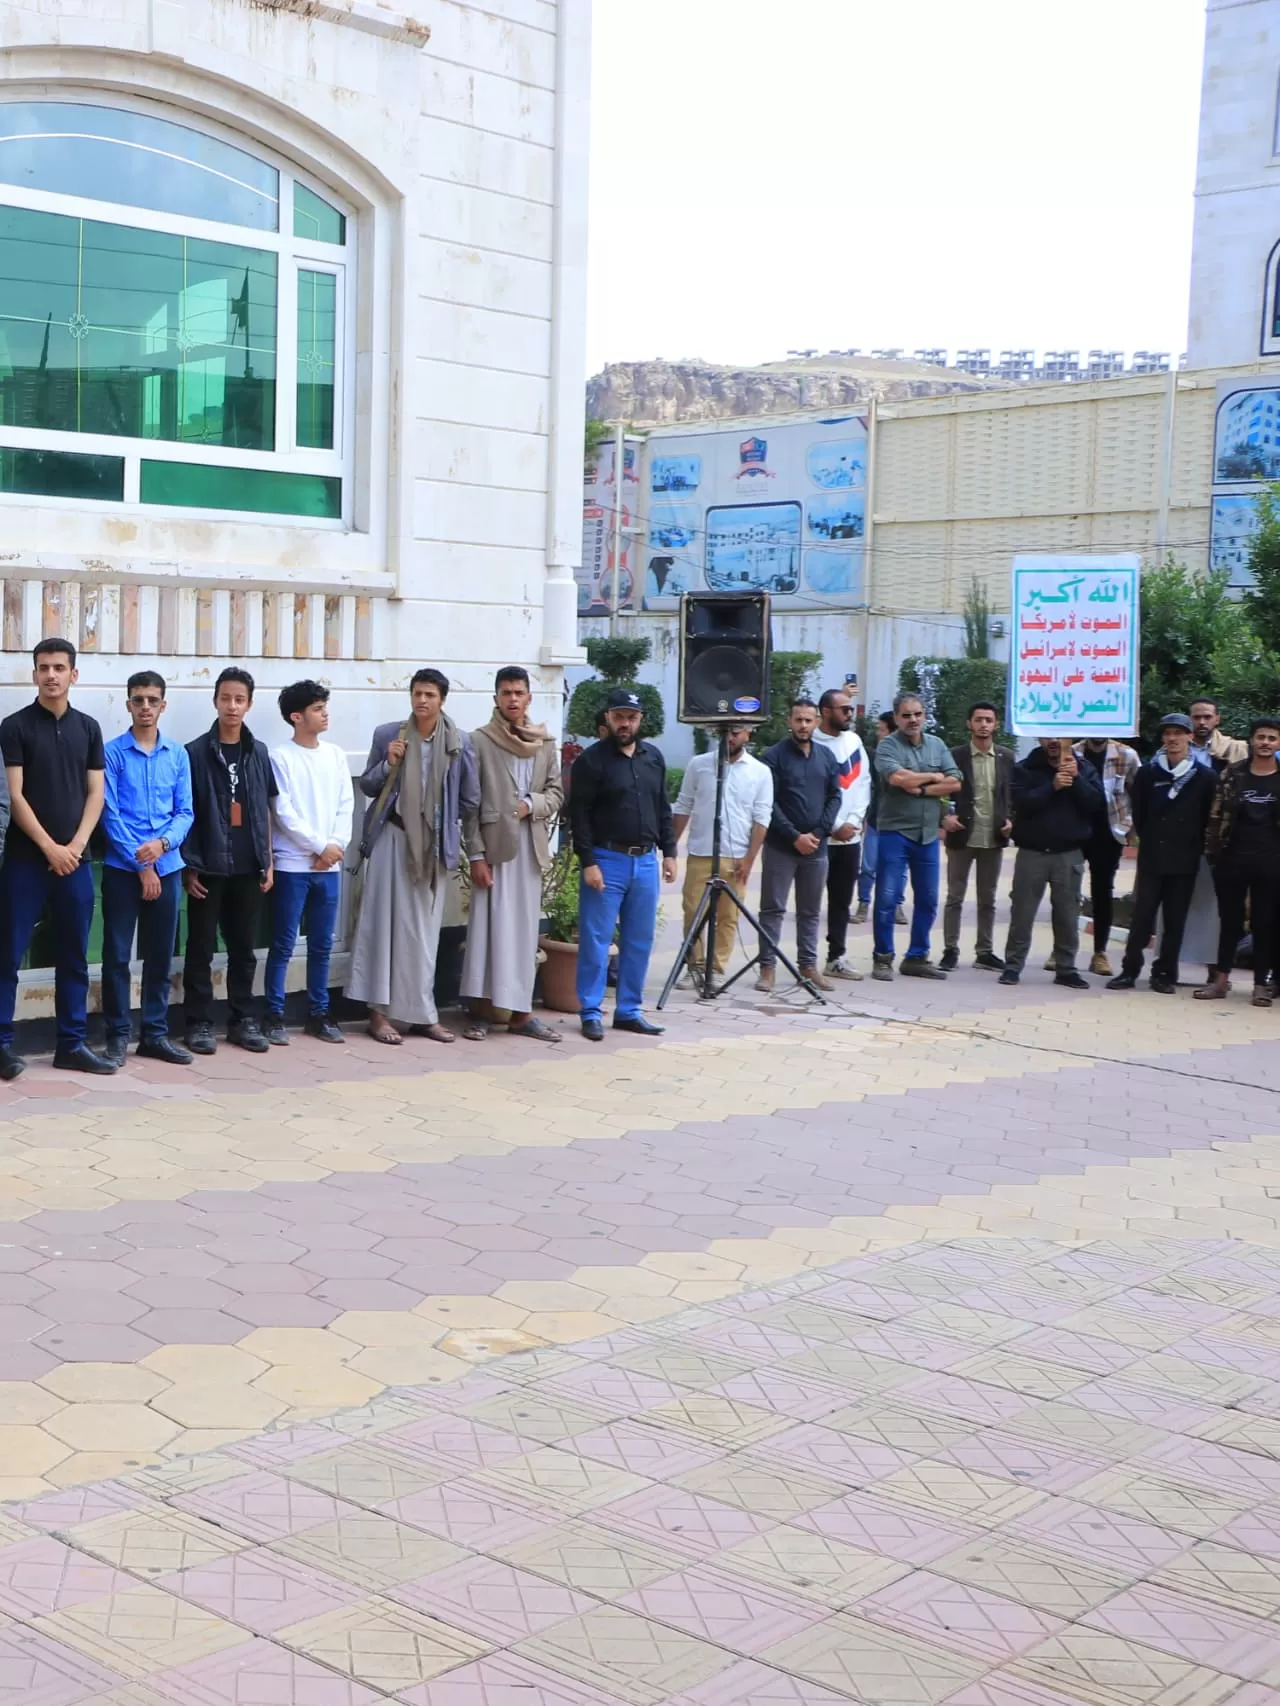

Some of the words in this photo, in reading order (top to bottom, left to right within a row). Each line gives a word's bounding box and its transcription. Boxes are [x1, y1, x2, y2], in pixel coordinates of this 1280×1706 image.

[1020, 575, 1085, 611] أكبر
[1087, 577, 1128, 603] الله
[1020, 610, 1076, 634] لأمريكا
[1080, 613, 1128, 633] الموت
[1020, 639, 1076, 661] لإسرائيل
[1080, 640, 1126, 660] الموت
[1019, 666, 1058, 687] اليهود
[1063, 667, 1085, 687] على
[1091, 665, 1126, 683] اللعنة
[1076, 689, 1125, 719] النصر
